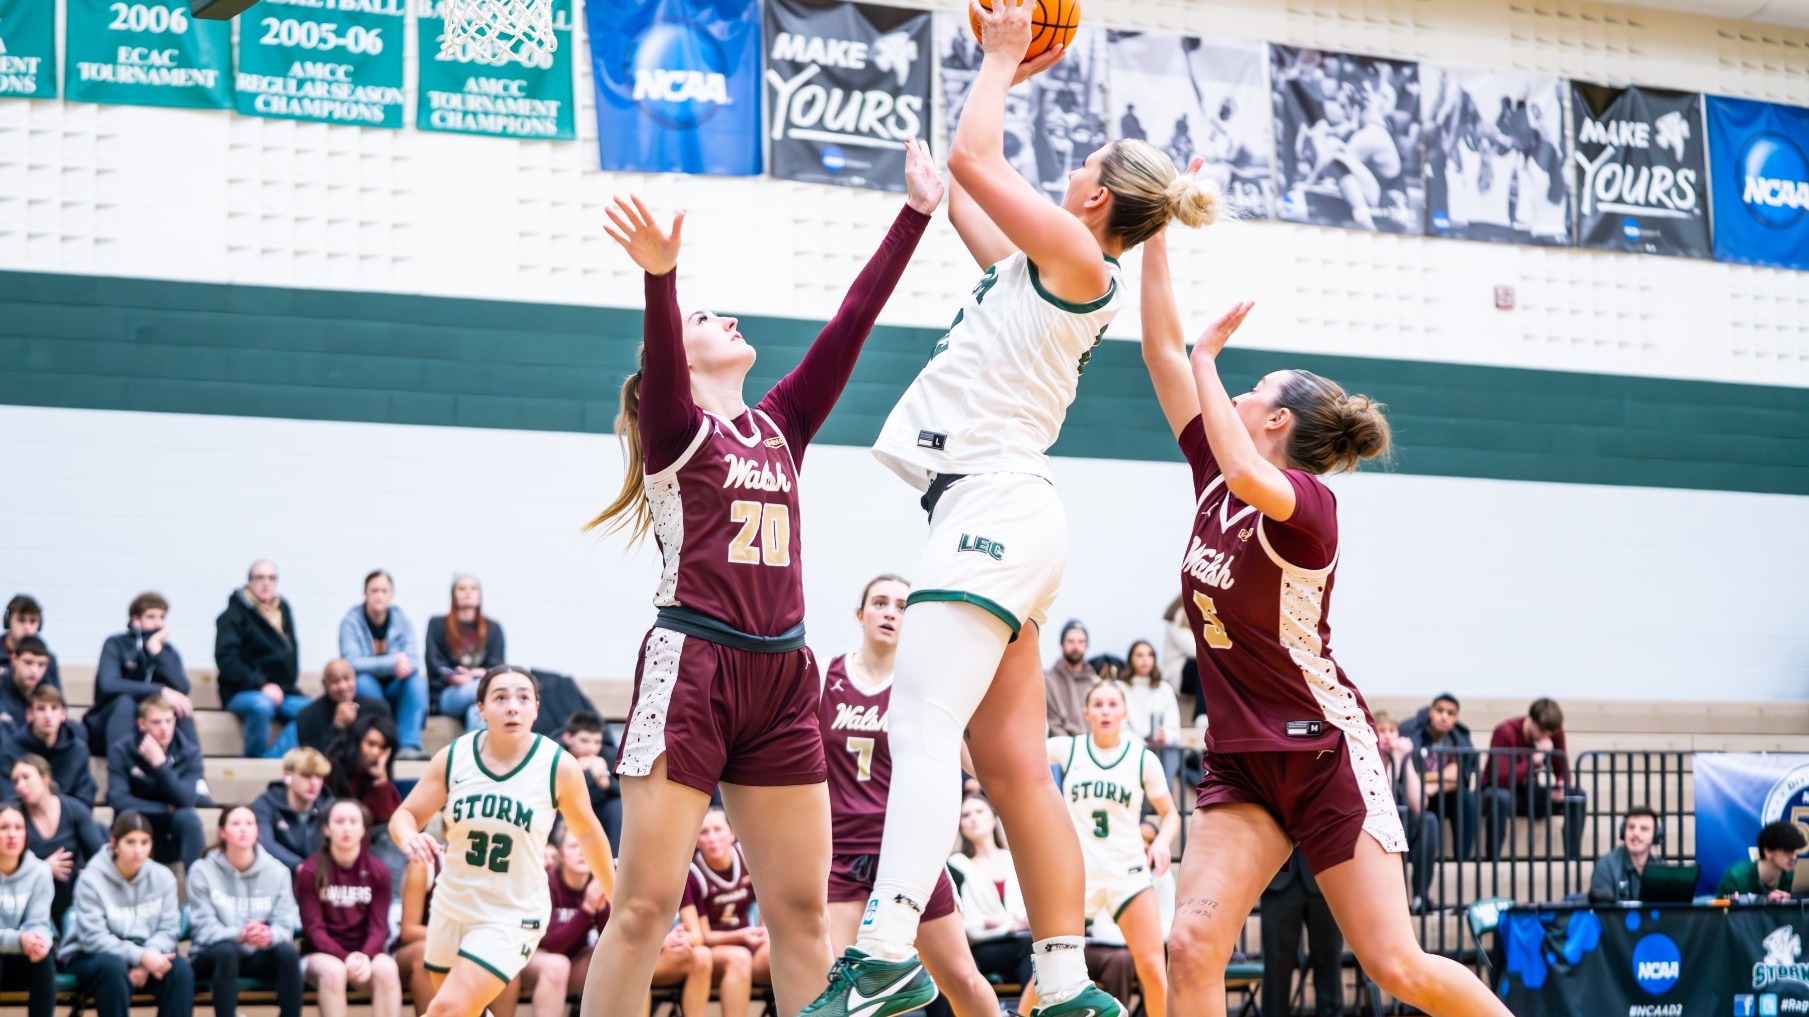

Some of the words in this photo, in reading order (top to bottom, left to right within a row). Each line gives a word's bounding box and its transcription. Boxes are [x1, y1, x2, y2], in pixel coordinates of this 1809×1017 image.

[108, 2, 188, 34] 2006
[259, 17, 384, 55] 2005-06
[771, 32, 868, 69] MAKE
[117, 46, 179, 66] ECAC
[288, 61, 354, 82] AMCC
[77, 62, 219, 88] TOURNAMENT
[235, 72, 329, 100] REGULAR
[330, 81, 403, 105] SEASON
[463, 76, 527, 97] AMCC
[633, 69, 732, 105] NCAA
[254, 94, 385, 123] CHAMPIONS
[427, 90, 561, 118] TOURNAMENT
[766, 63, 923, 141] YOURS
[430, 109, 557, 135] CHAMPIONS
[1579, 117, 1650, 148] MAKE
[1575, 145, 1697, 216] YOURS
[1743, 175, 1809, 210] NCAA
[722, 454, 791, 493] Walsh
[728, 500, 790, 567] 20
[957, 533, 1005, 561] LEC
[1182, 535, 1235, 590] Walsh
[1193, 589, 1233, 650] 5
[830, 702, 888, 733] Walsh
[1310, 724, 1319, 732] M
[845, 736, 875, 781] 7
[1071, 780, 1132, 808] STORM
[452, 793, 533, 833] STORM
[1091, 810, 1109, 838] 3
[465, 829, 513, 874] 32
[1638, 961, 1679, 980] NCAA
